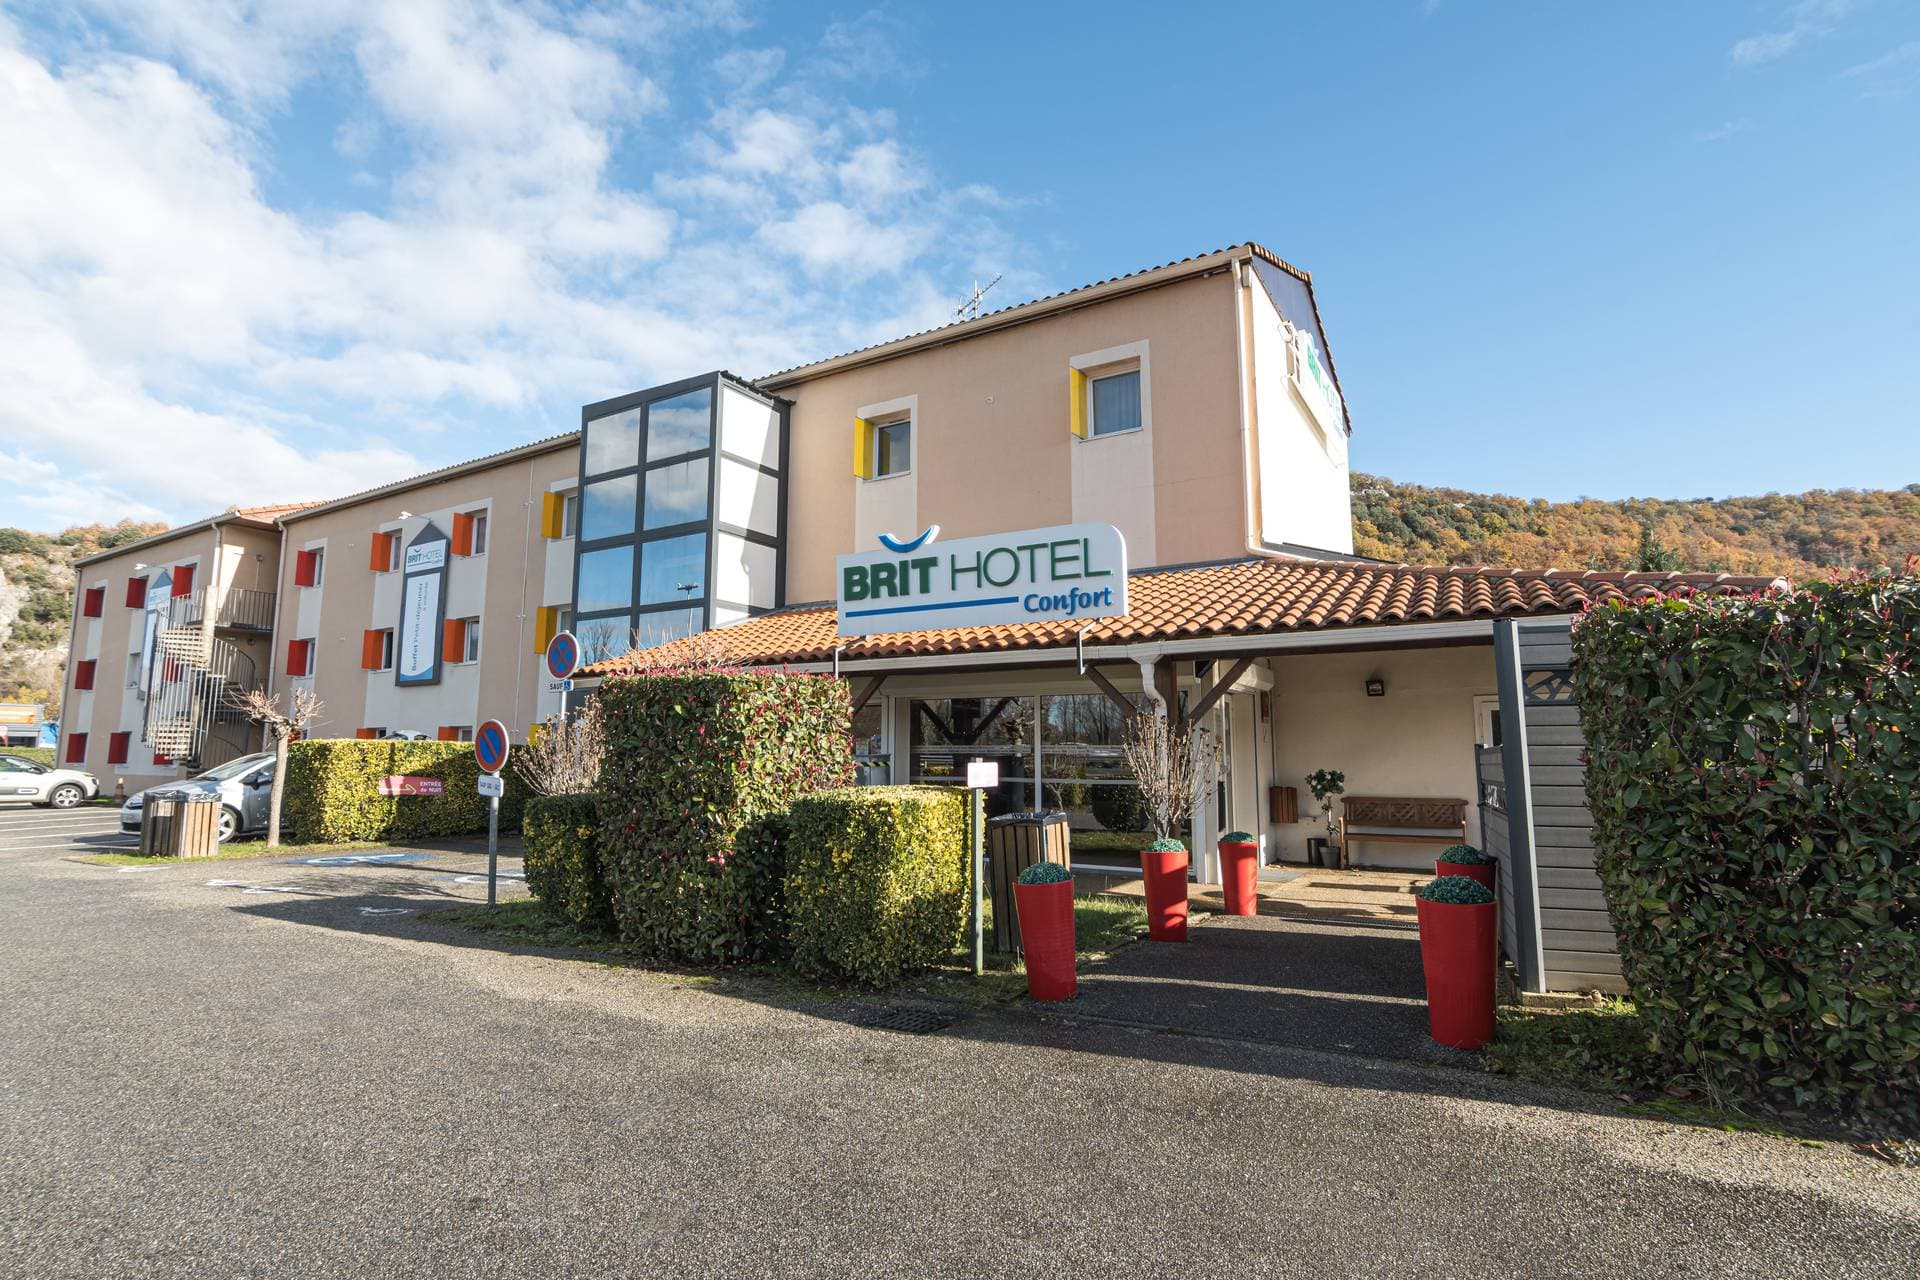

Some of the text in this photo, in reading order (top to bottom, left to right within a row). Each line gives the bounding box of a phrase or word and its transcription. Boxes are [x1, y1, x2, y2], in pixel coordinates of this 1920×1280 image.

[408, 553, 421, 564] BRIT
[423, 549, 442, 561] HOTEL
[844, 538, 1112, 601] BRIT HOTEL
[1024, 586, 1112, 615] Confort
[549, 682, 563, 690] SAUF
